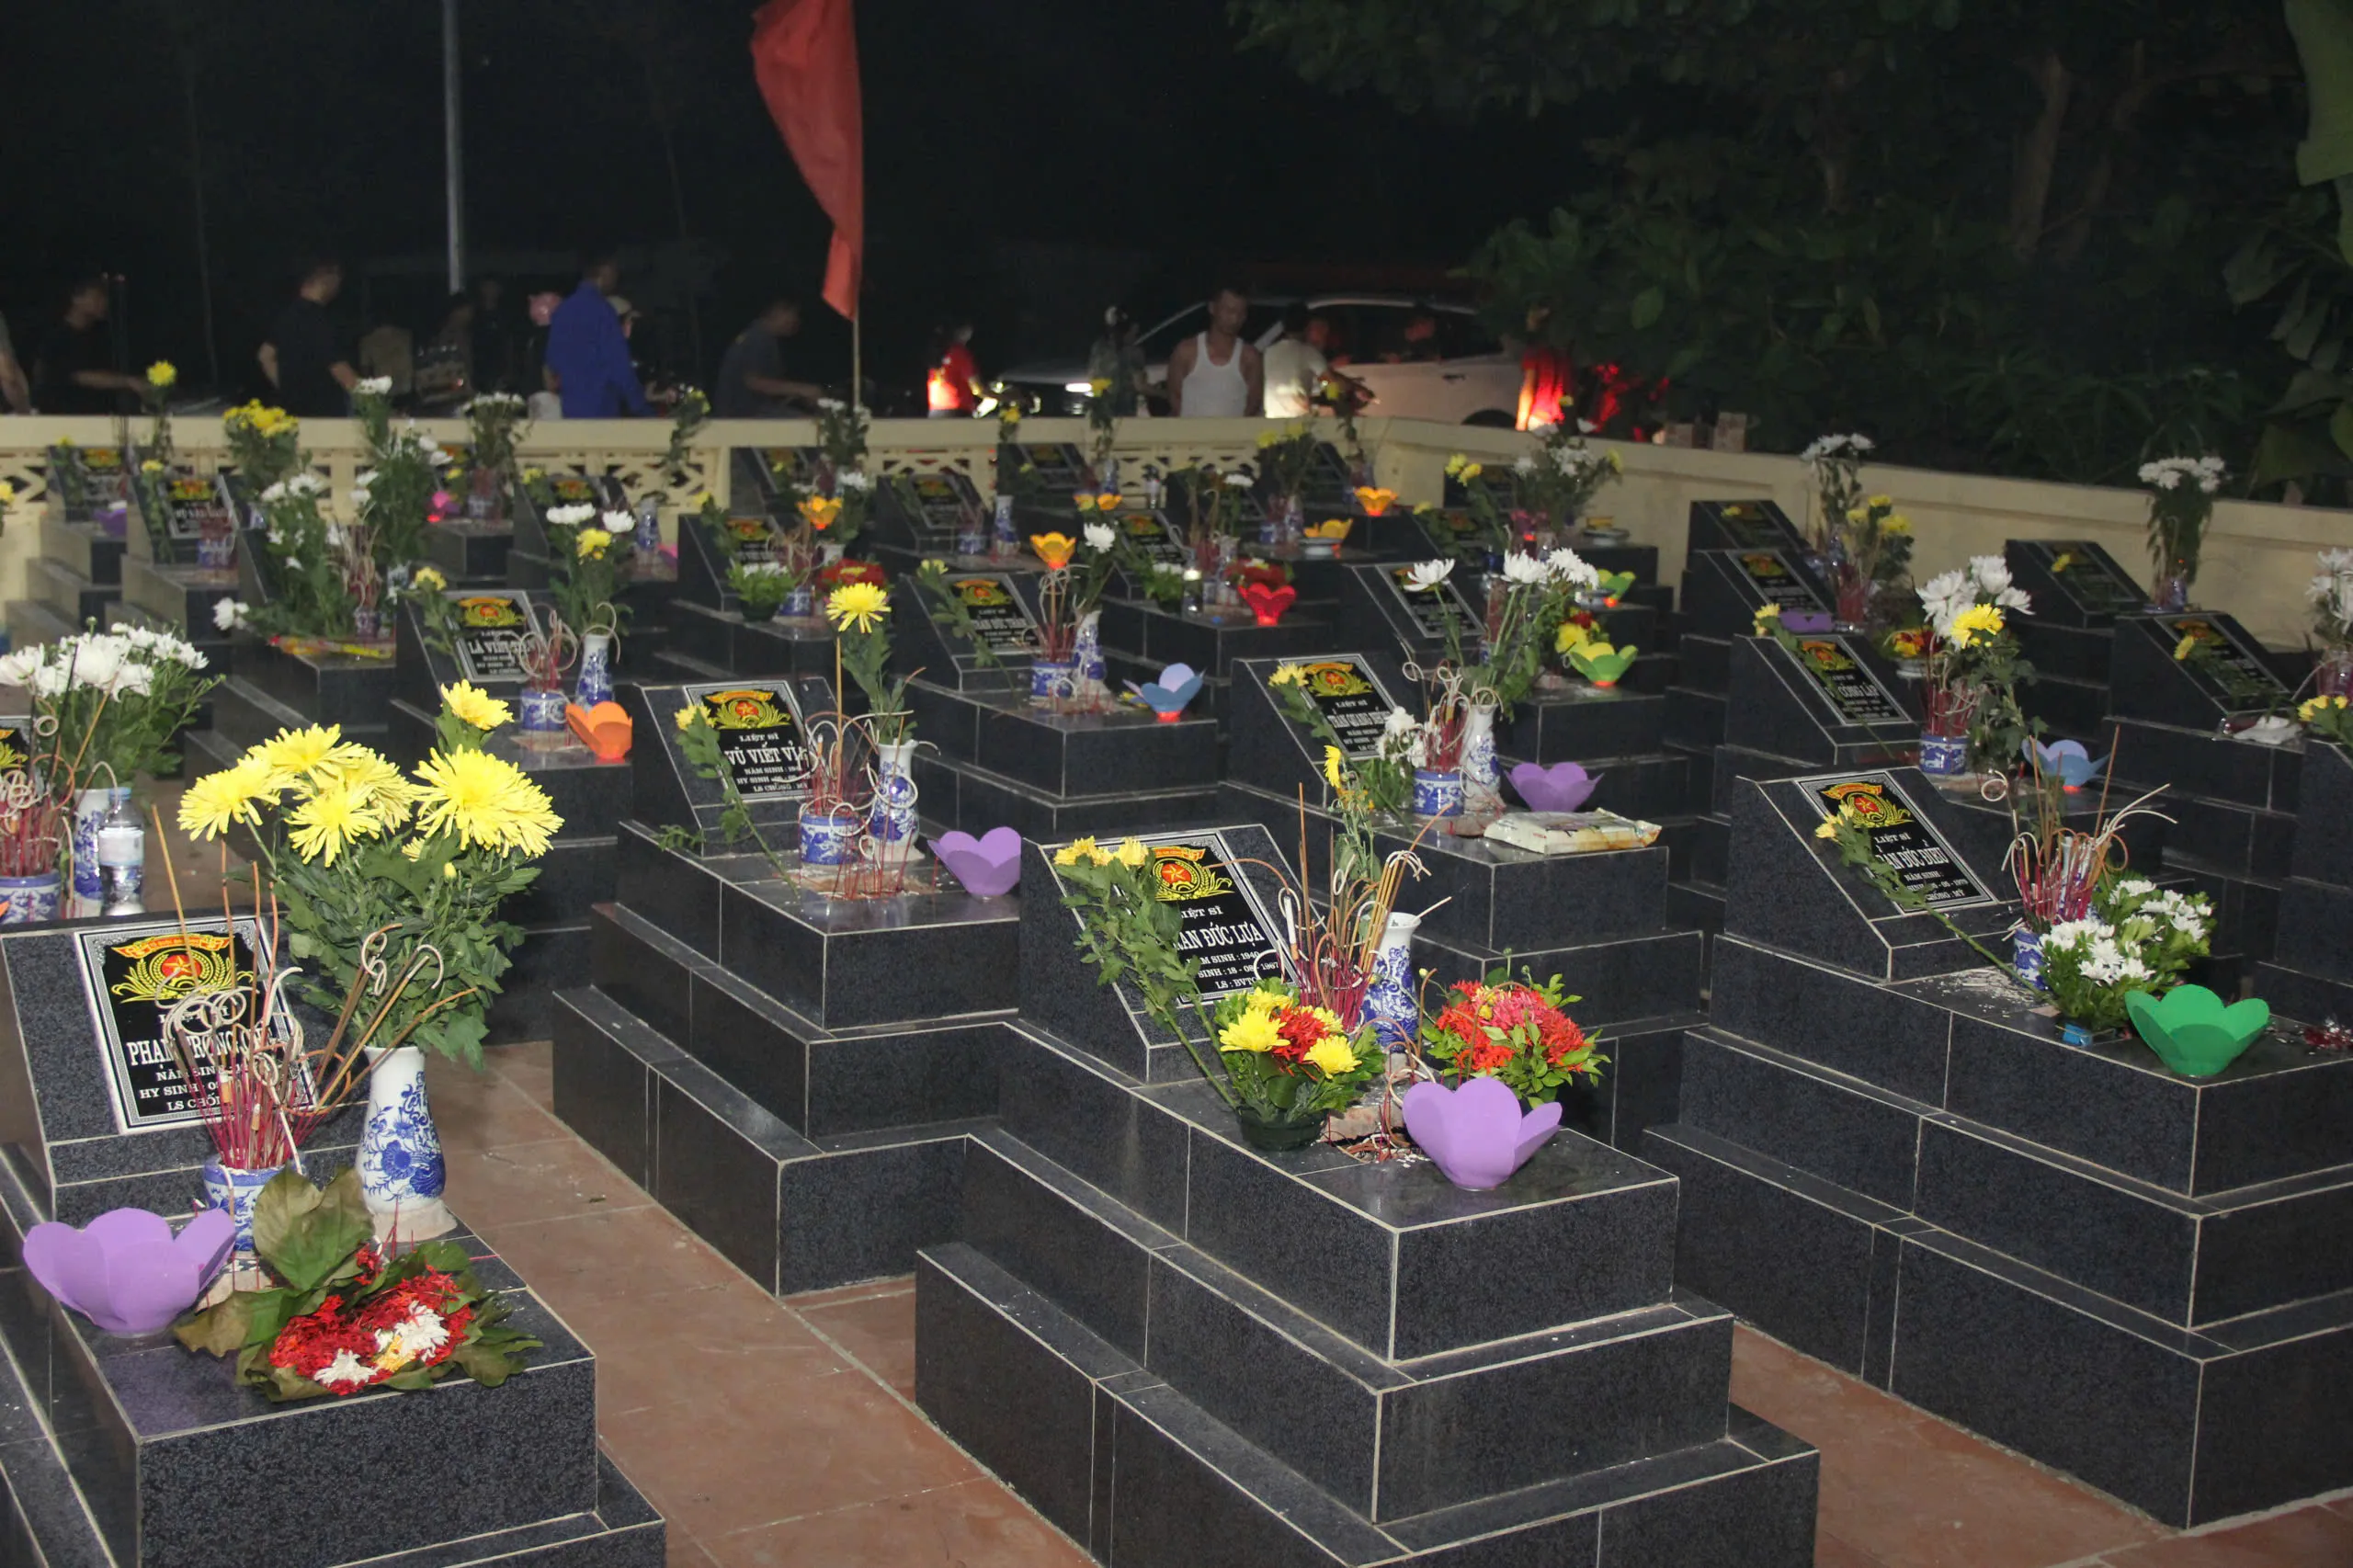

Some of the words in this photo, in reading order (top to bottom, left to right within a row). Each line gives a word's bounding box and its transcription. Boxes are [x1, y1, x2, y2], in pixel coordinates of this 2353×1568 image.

[746, 741, 782, 764] VIẾT
[1199, 921, 1234, 948] ĐỨC
[1211, 953, 1236, 964] SINH
[1198, 968, 1222, 978] SINH
[1214, 981, 1229, 989] LS
[140, 1087, 161, 1099] HY
[166, 1100, 185, 1111] LS
